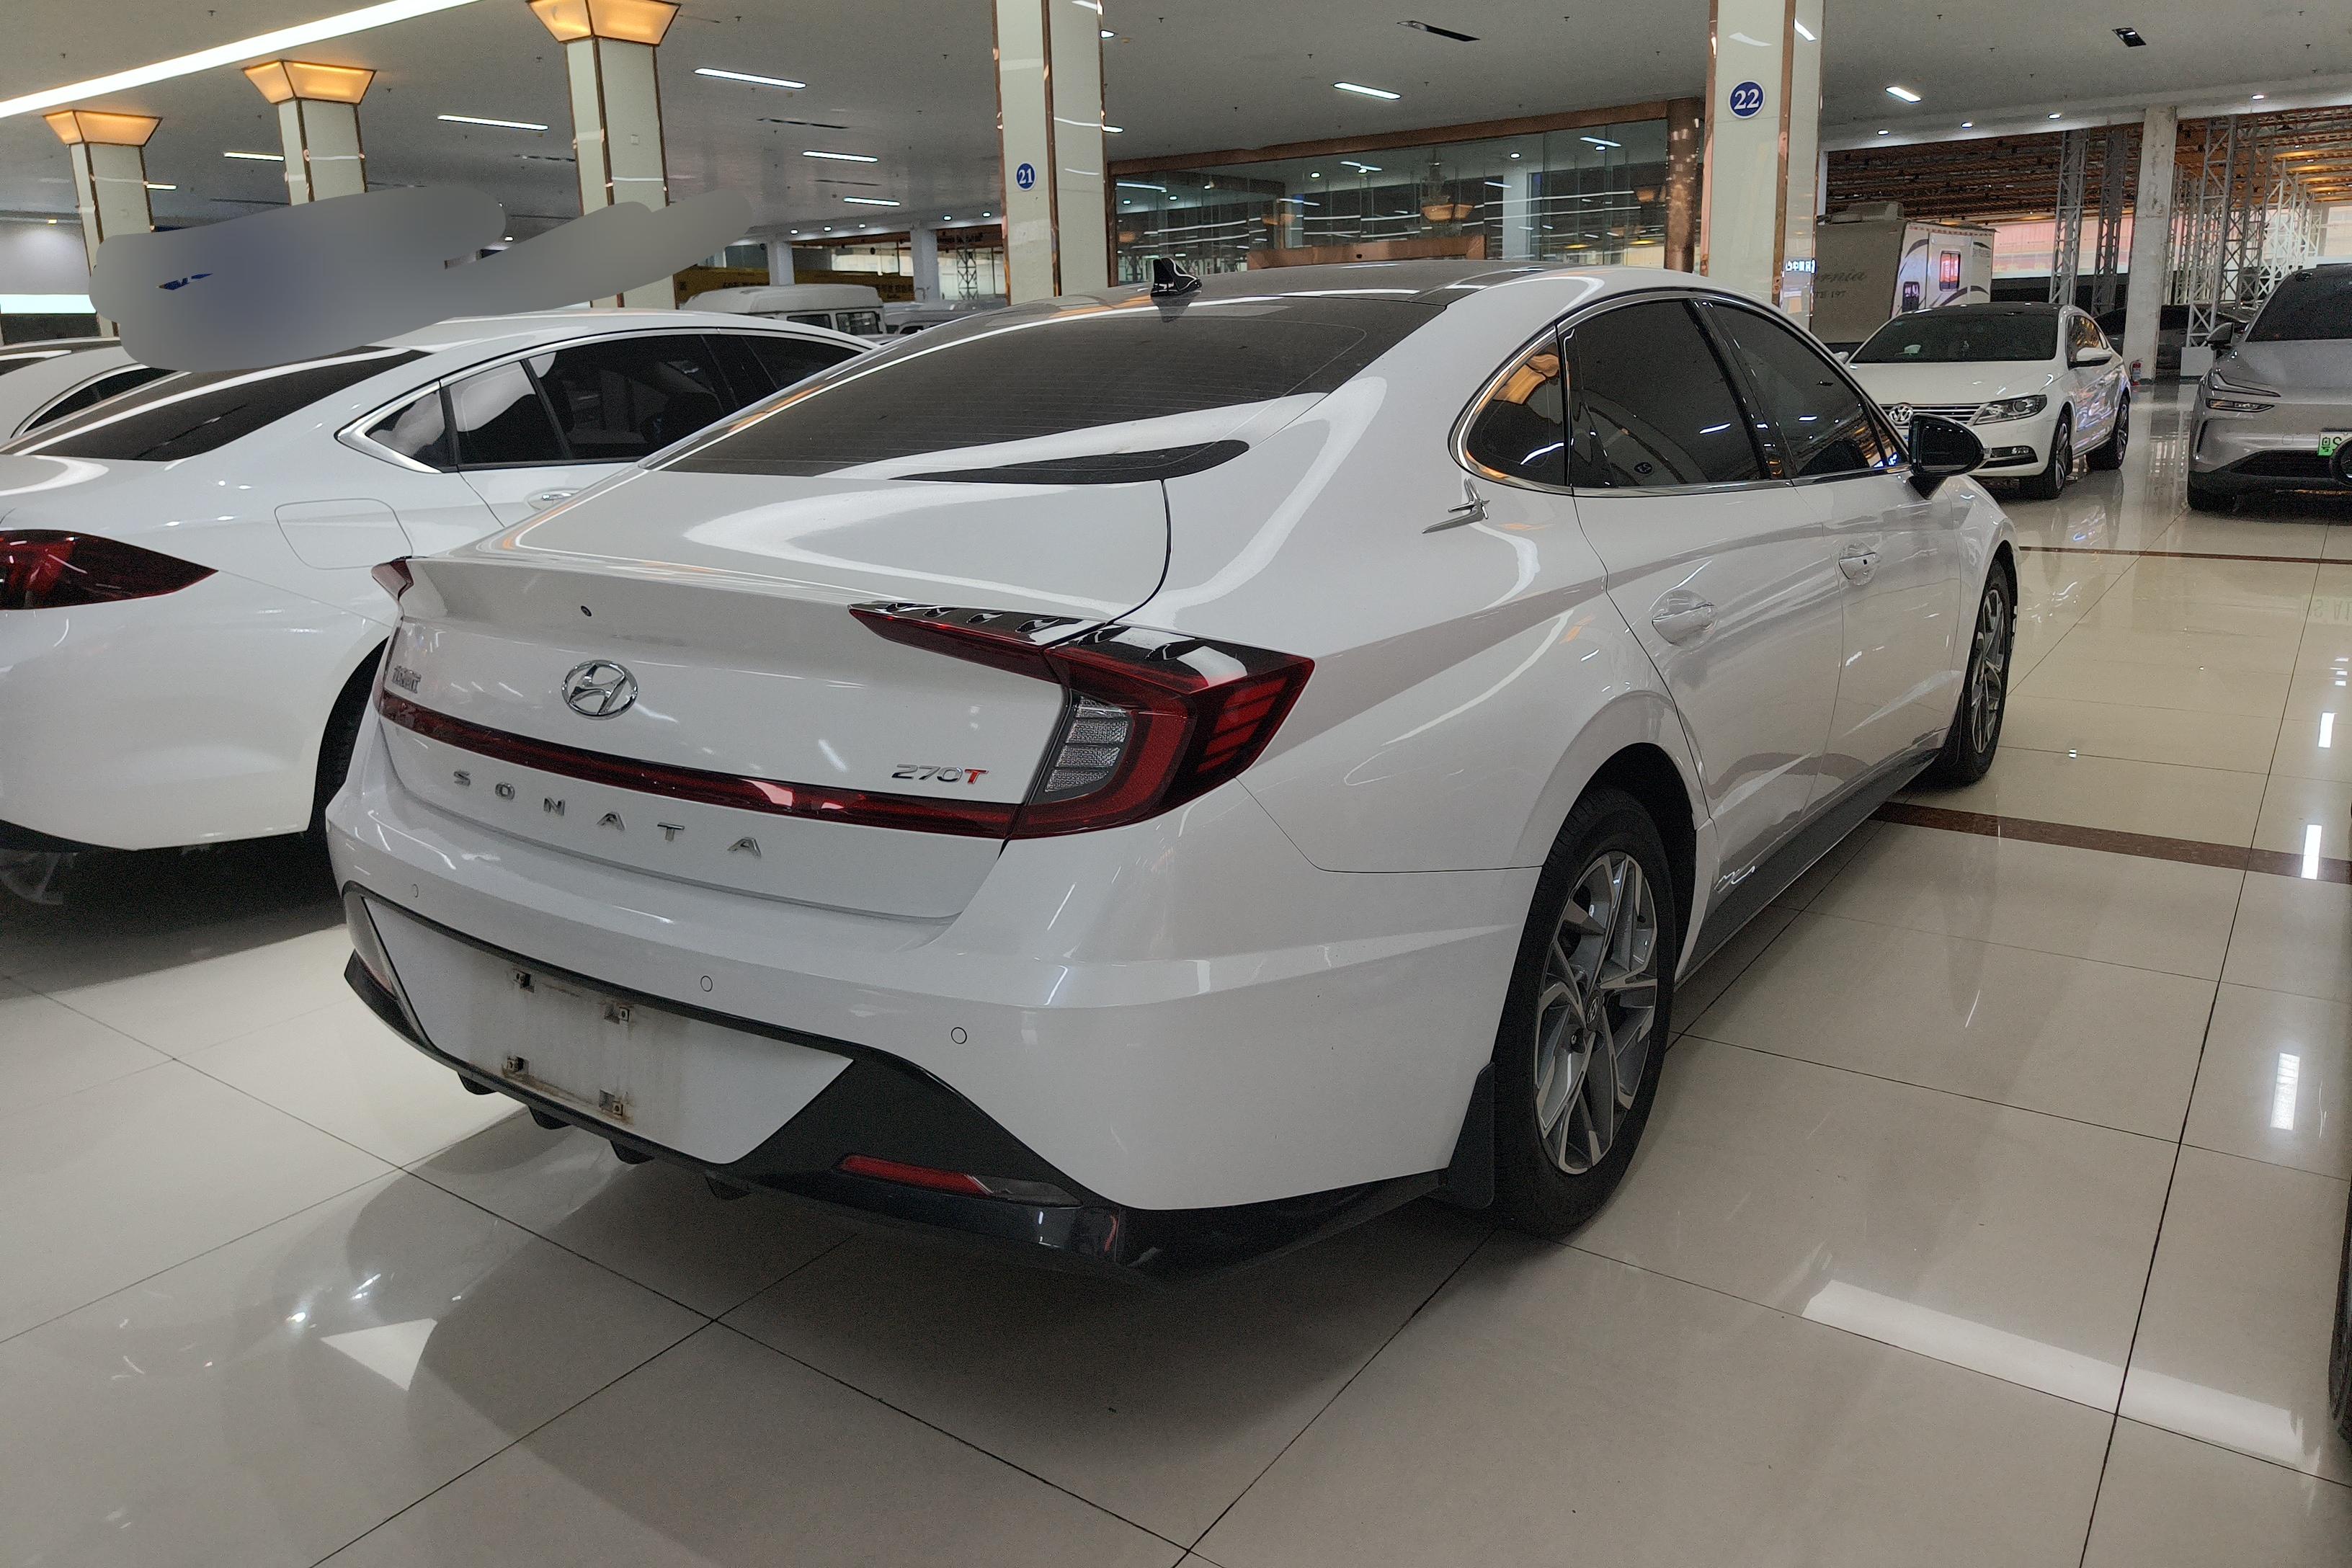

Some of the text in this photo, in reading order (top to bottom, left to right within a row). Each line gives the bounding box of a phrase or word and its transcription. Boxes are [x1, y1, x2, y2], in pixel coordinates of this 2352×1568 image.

[1734, 89, 1760, 110] 22
[1018, 168, 1033, 184] 21
[891, 764, 989, 785] 270T
[453, 769, 762, 859] SONATA
